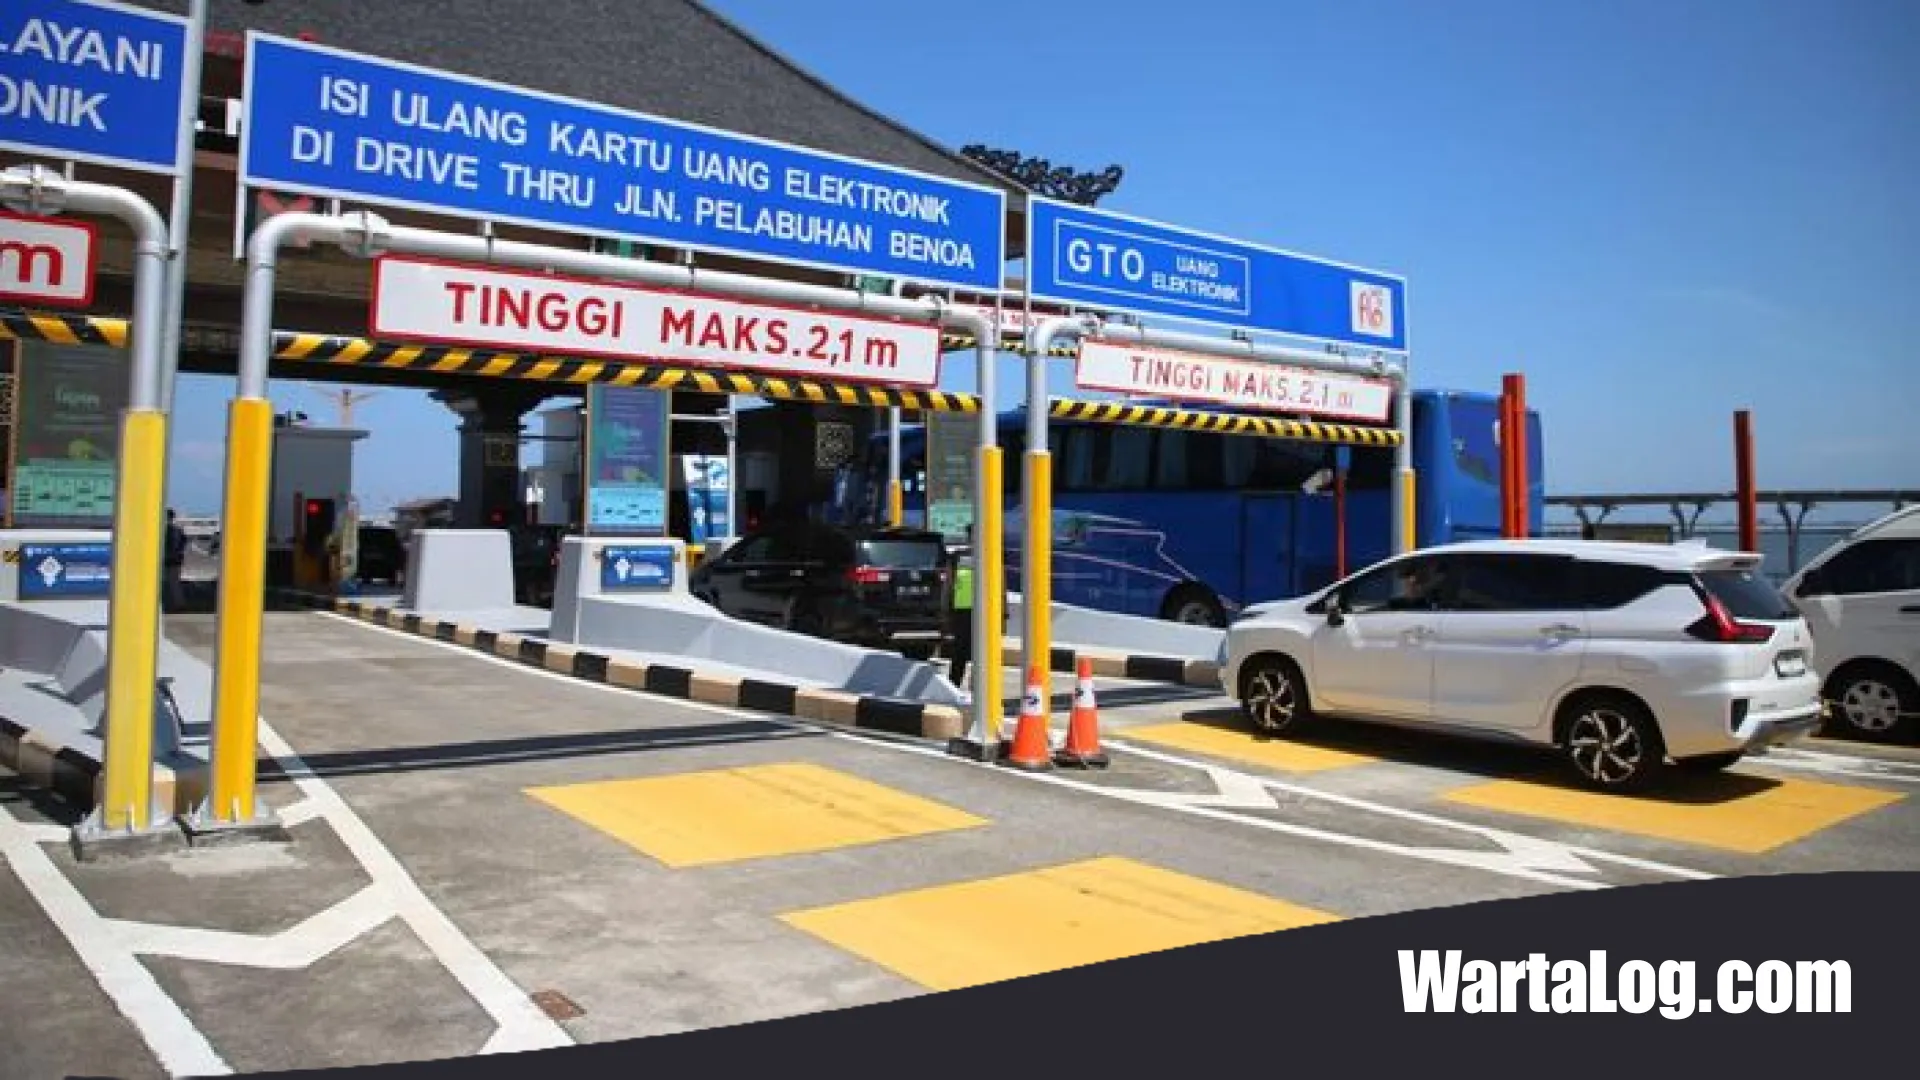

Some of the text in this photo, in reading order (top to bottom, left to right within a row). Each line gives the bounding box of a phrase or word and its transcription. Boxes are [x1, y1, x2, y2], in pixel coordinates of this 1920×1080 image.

[0, 18, 163, 80] AYANI
[320, 76, 950, 226] ISI ULANG KARTU UANG ELEKTRONIK
[292, 125, 976, 269] DI DRIVE THRU JLN. PELABUHAN BENOA
[1067, 238, 1145, 282] GTO
[444, 282, 623, 339] TINGGI
[1130, 355, 1212, 391] TINGGI
